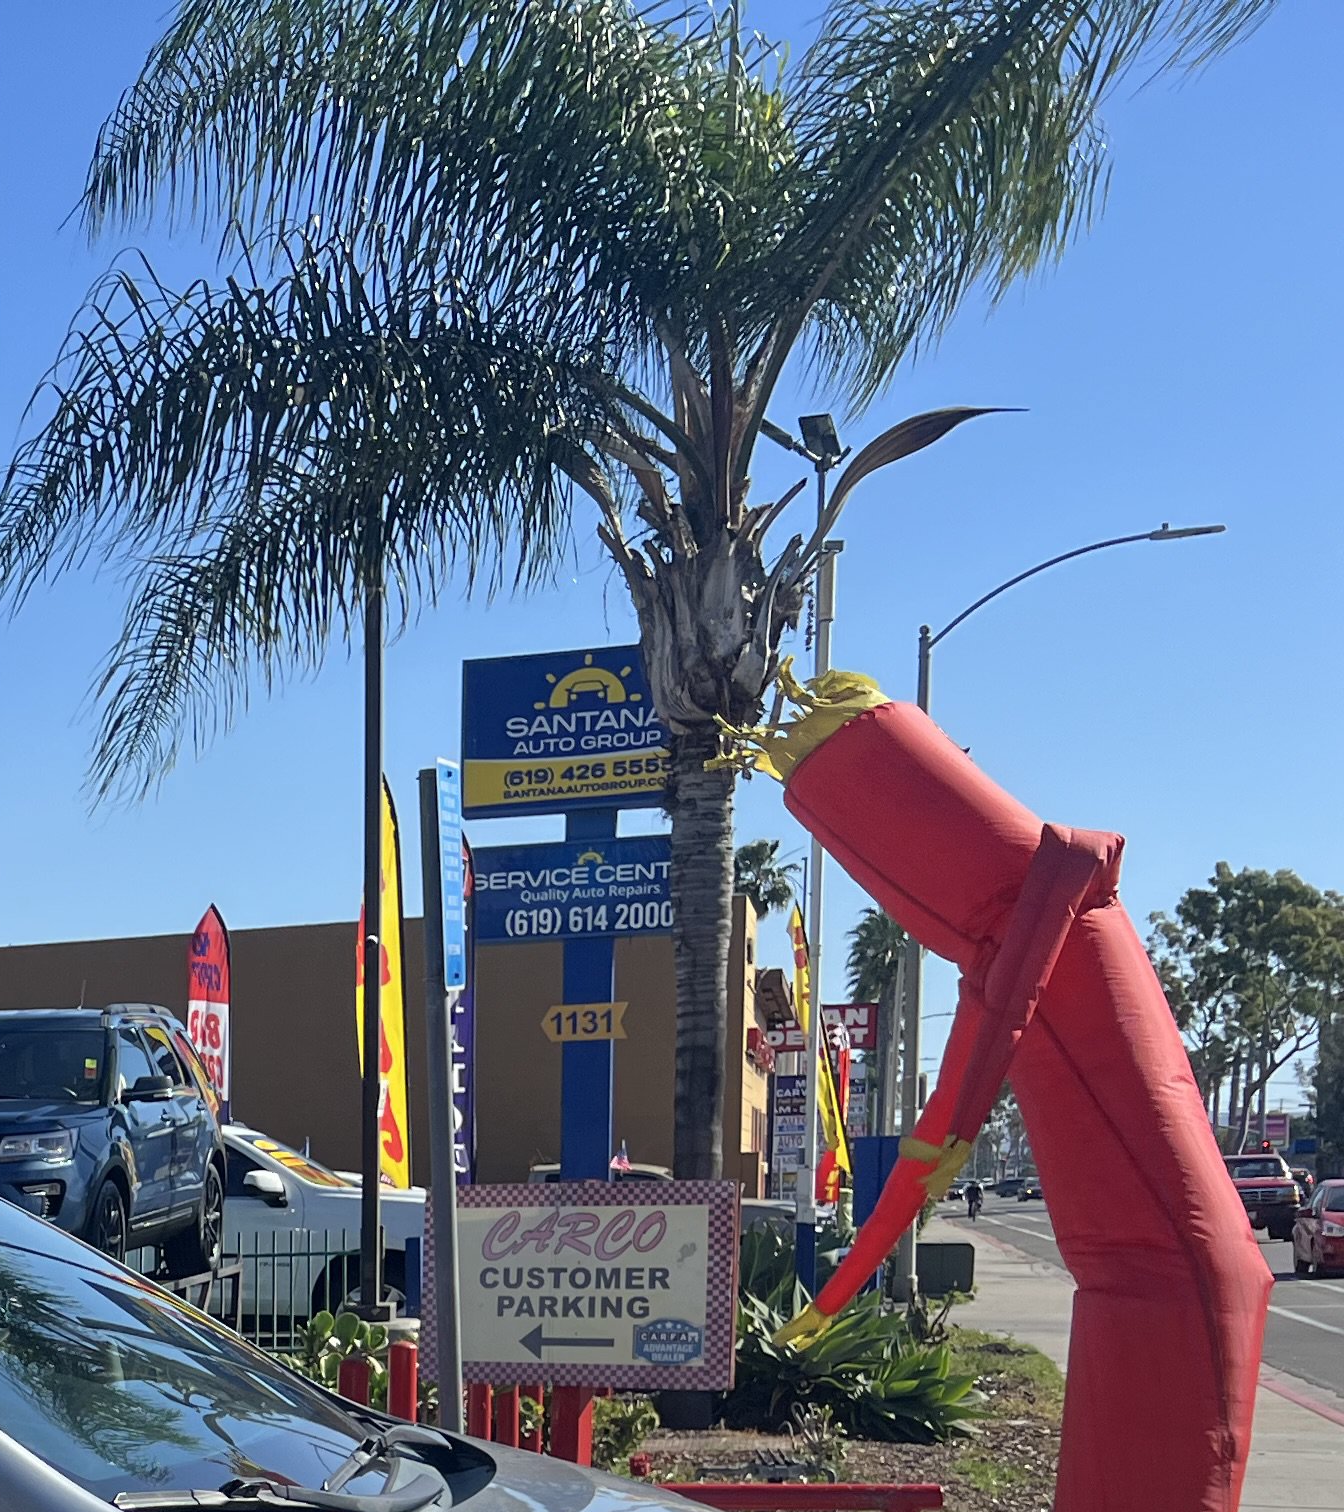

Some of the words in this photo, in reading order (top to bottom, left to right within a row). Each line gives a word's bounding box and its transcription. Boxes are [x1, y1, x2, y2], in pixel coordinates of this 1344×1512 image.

[505, 706, 663, 738] SANTANA
[512, 738, 576, 756] AUTO
[580, 730, 662, 751] GROUP
[503, 767, 555, 788] (619)
[560, 763, 607, 781] 426
[474, 866, 590, 891] SERVICE
[595, 861, 673, 884] CENT
[520, 889, 570, 904] Quality
[571, 887, 606, 900] Auto
[505, 907, 562, 937] (619)
[568, 905, 609, 932] 614
[614, 901, 674, 930] 2000
[549, 1010, 613, 1036] 1131
[482, 1210, 668, 1262] CARCO
[479, 1267, 670, 1290] CUSTOMER
[497, 1296, 651, 1319] PARKING
[642, 1343, 694, 1354] ADVANTAGE
[650, 1352, 686, 1363] DEALER
